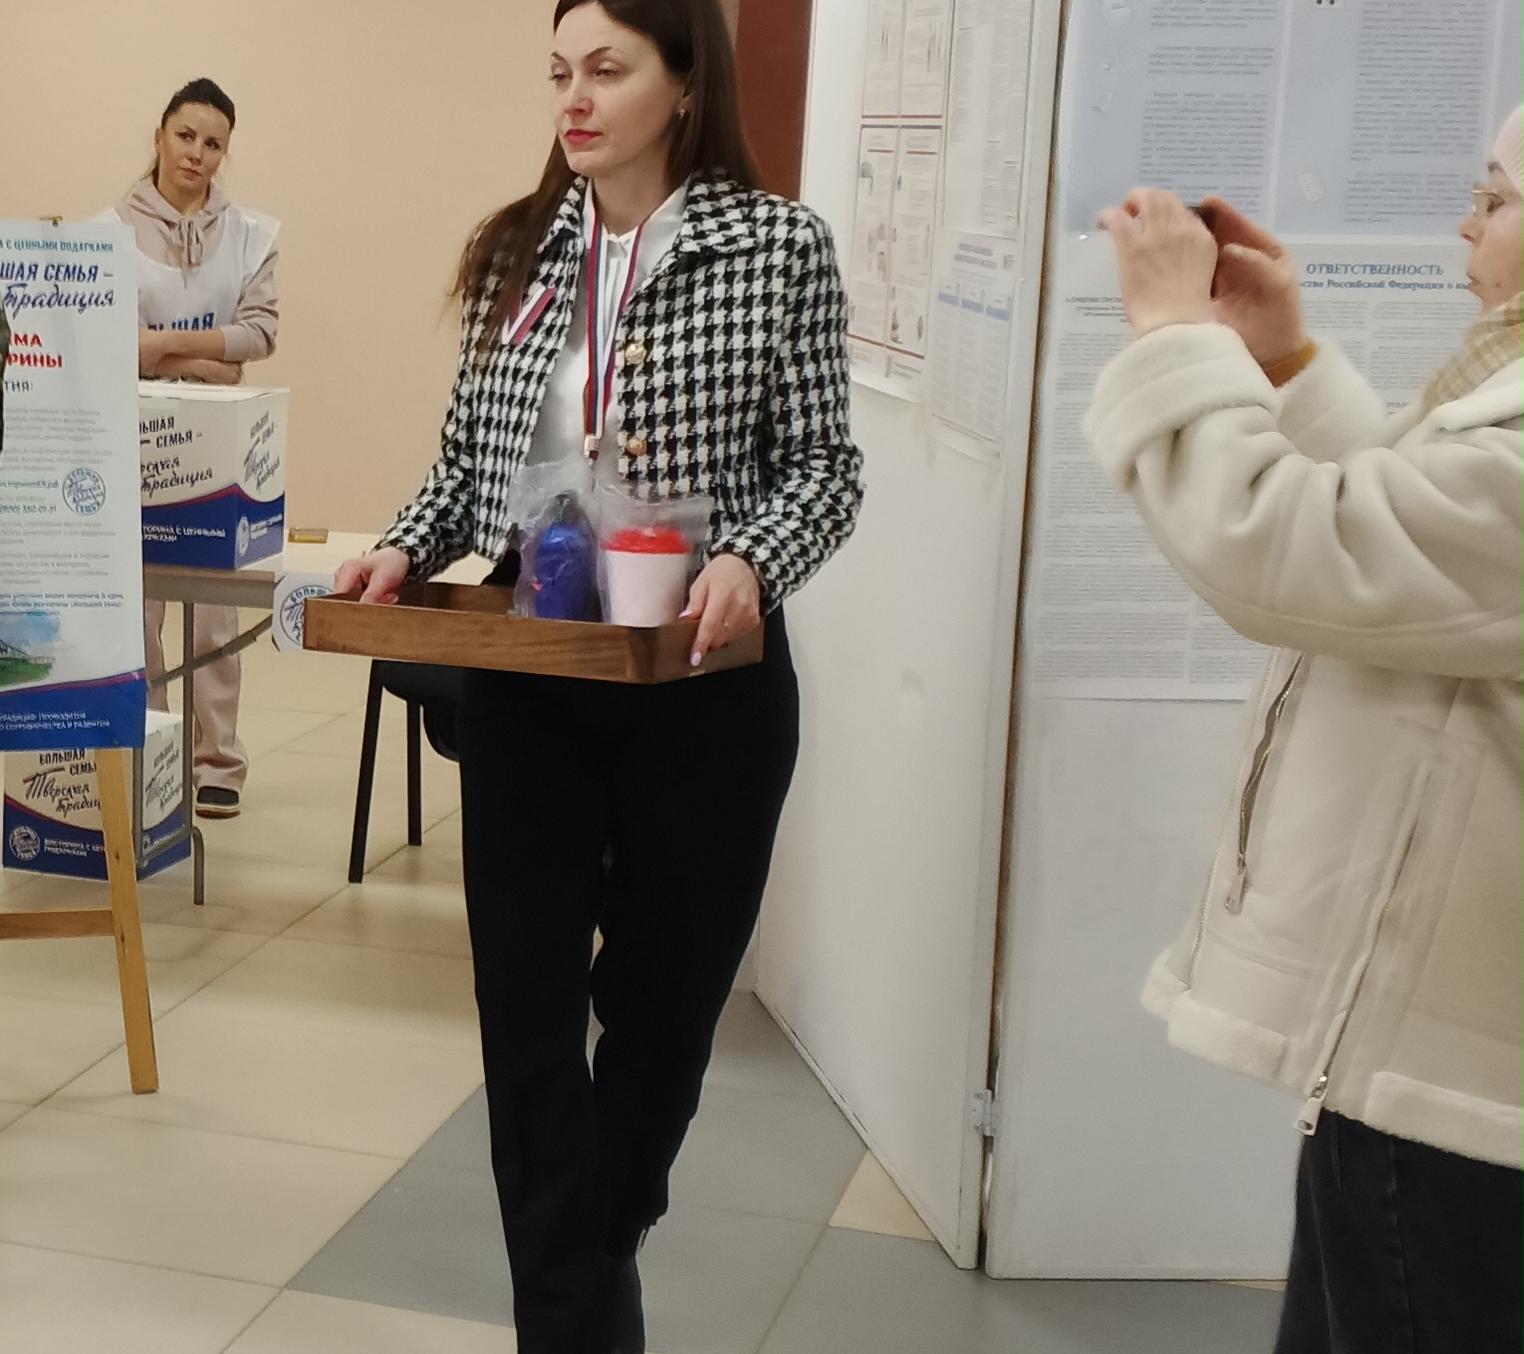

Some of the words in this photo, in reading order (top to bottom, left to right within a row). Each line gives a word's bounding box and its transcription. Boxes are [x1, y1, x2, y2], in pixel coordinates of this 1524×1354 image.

[44, 264, 99, 283] СЕМЬЯ
[1306, 263, 1443, 275] ОТВЕТСТВЕННОСТЬ
[10, 333, 43, 348] МА
[6, 353, 63, 368] РИНЫ
[156, 429, 192, 448] СЕМЬЯ
[39, 749, 86, 765] БОЛЬШАЯ
[70, 762, 97, 775] СЕМЬ
